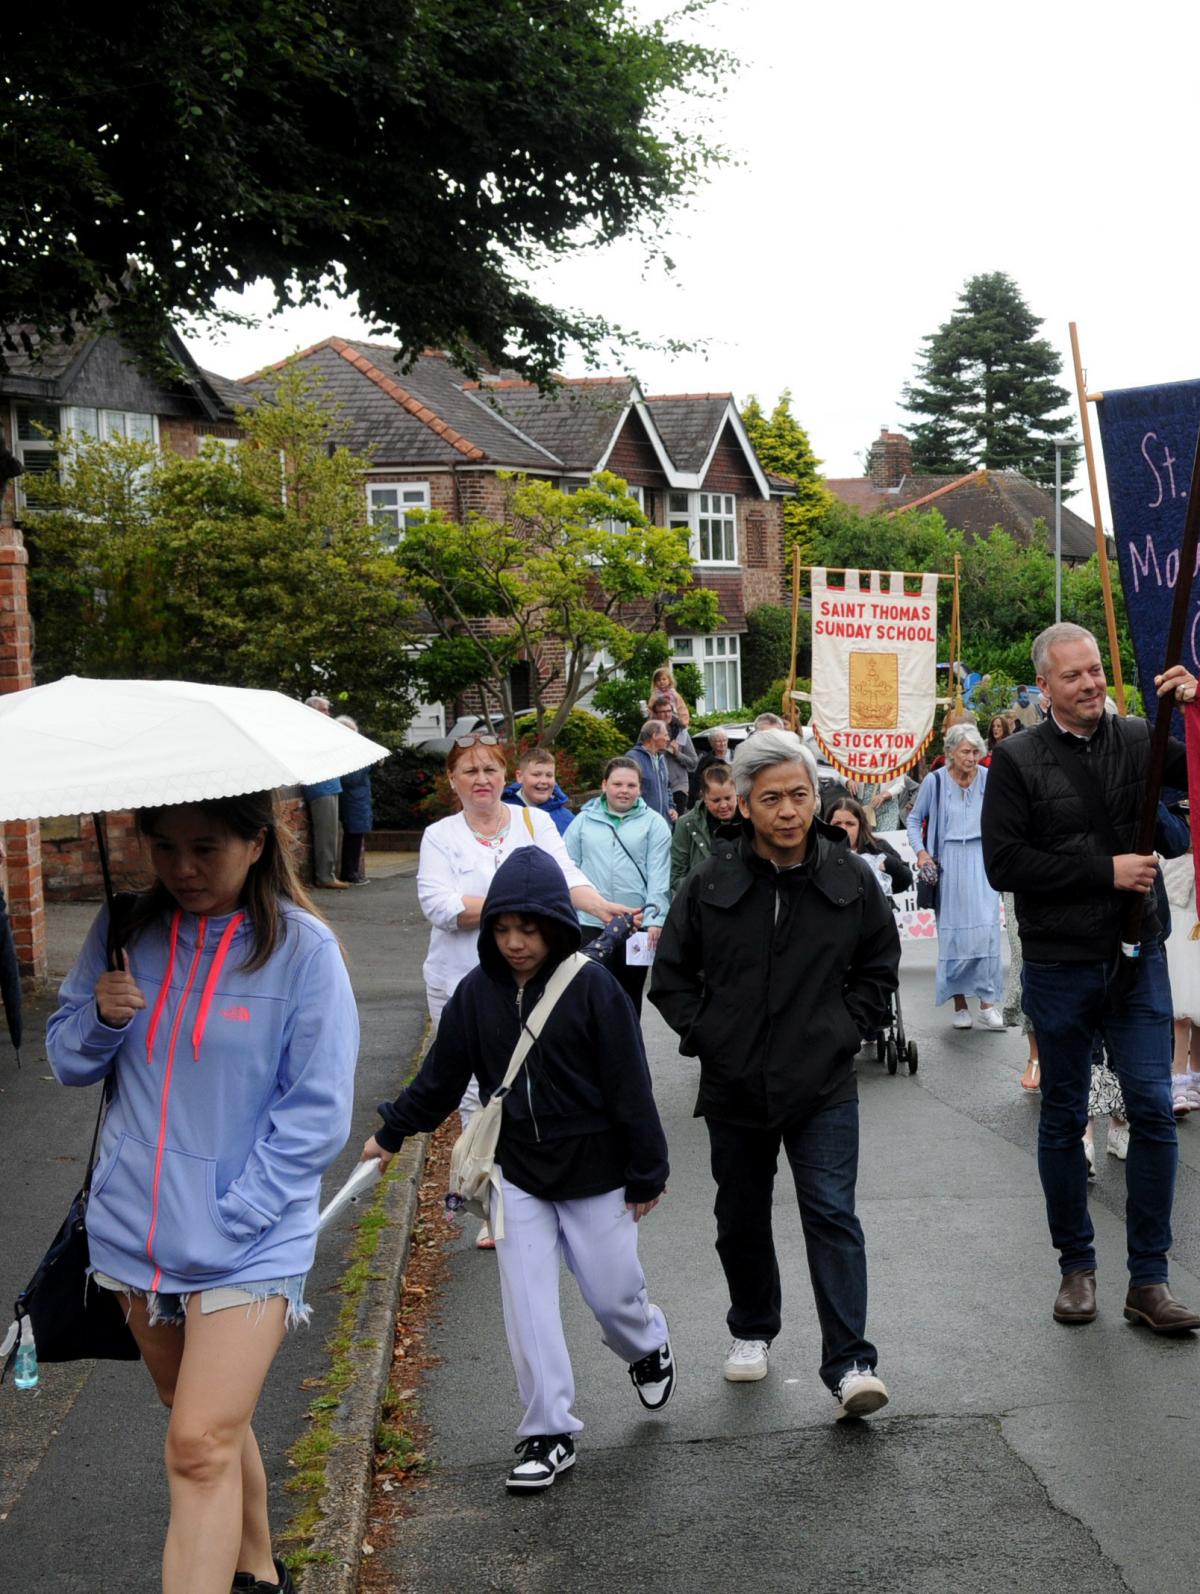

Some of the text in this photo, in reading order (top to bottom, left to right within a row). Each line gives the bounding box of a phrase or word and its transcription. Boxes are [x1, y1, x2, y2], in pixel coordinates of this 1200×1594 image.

[820, 601, 931, 621] SAINT THOMAS
[815, 620, 935, 642] SUNDAY SCHOOL
[832, 732, 915, 749] STOCKTON
[847, 752, 898, 768] HEATH
